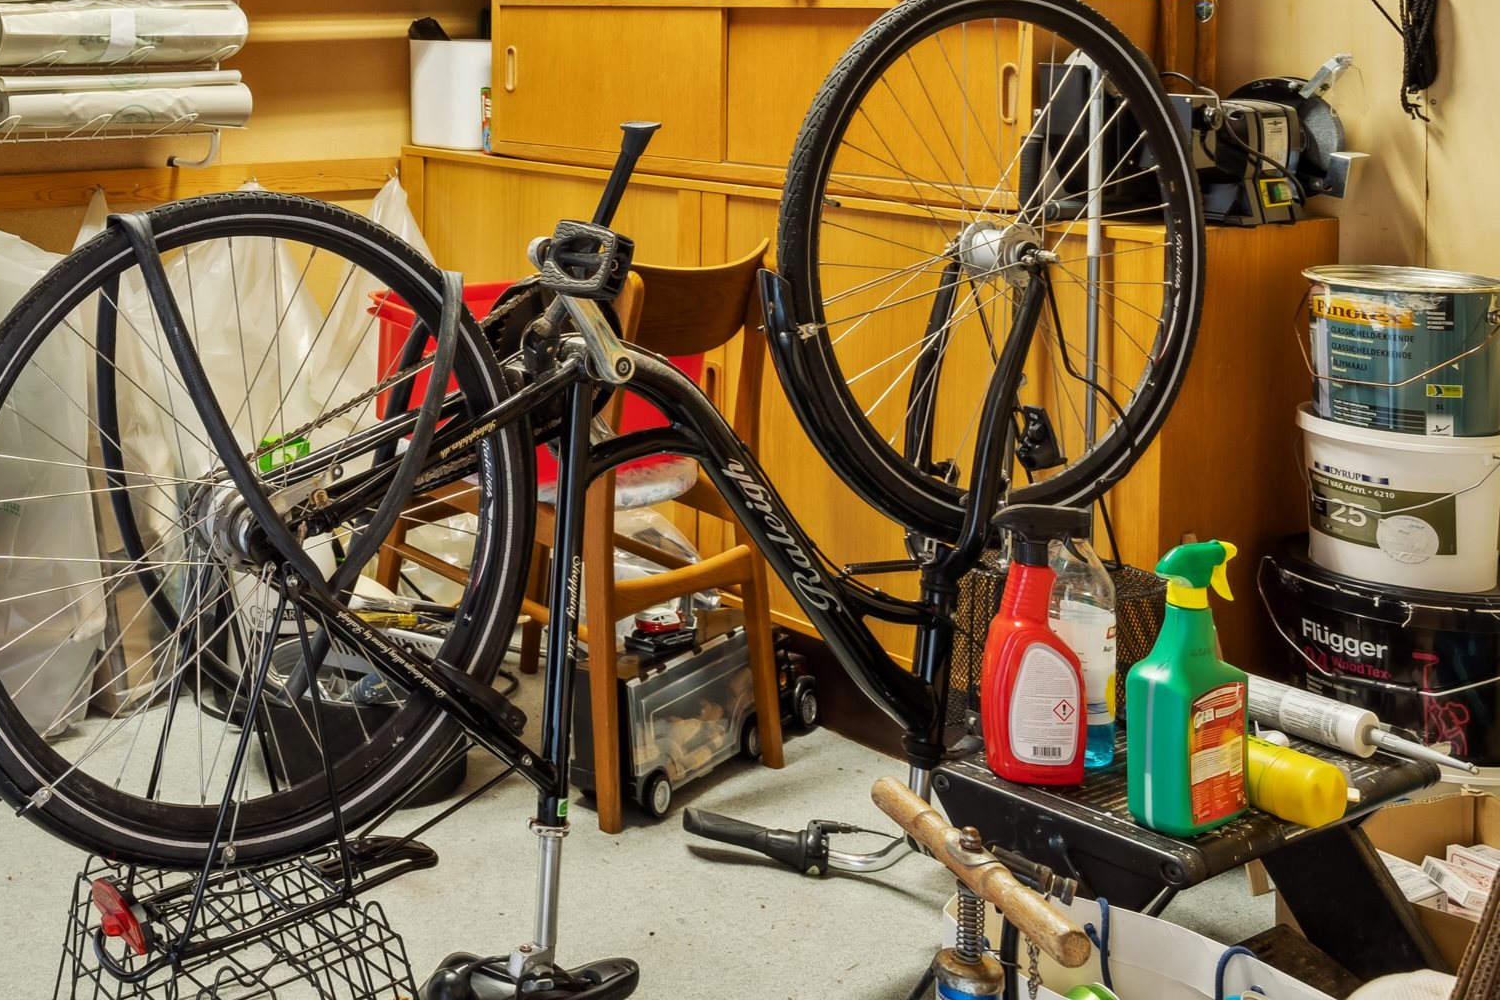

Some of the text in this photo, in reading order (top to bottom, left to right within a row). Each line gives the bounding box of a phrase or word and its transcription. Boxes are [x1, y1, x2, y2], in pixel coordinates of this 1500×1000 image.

[1174, 231, 1183, 289] Raleigh
[1331, 325, 1355, 337] CLASSIC
[1357, 330, 1415, 343] HELDÆKENDE
[1331, 342, 1356, 354] CLASSIC
[1329, 466, 1362, 481] DYRUP
[1344, 483, 1367, 495] ACRYL
[1373, 490, 1395, 499] 6210
[1329, 497, 1368, 527] 25
[721, 456, 842, 613] Raleigh
[566, 555, 581, 660] Shopping Ltd
[336, 609, 447, 700] Danish design alloy frame by Raleigh
[1301, 617, 1389, 659] Flügger
